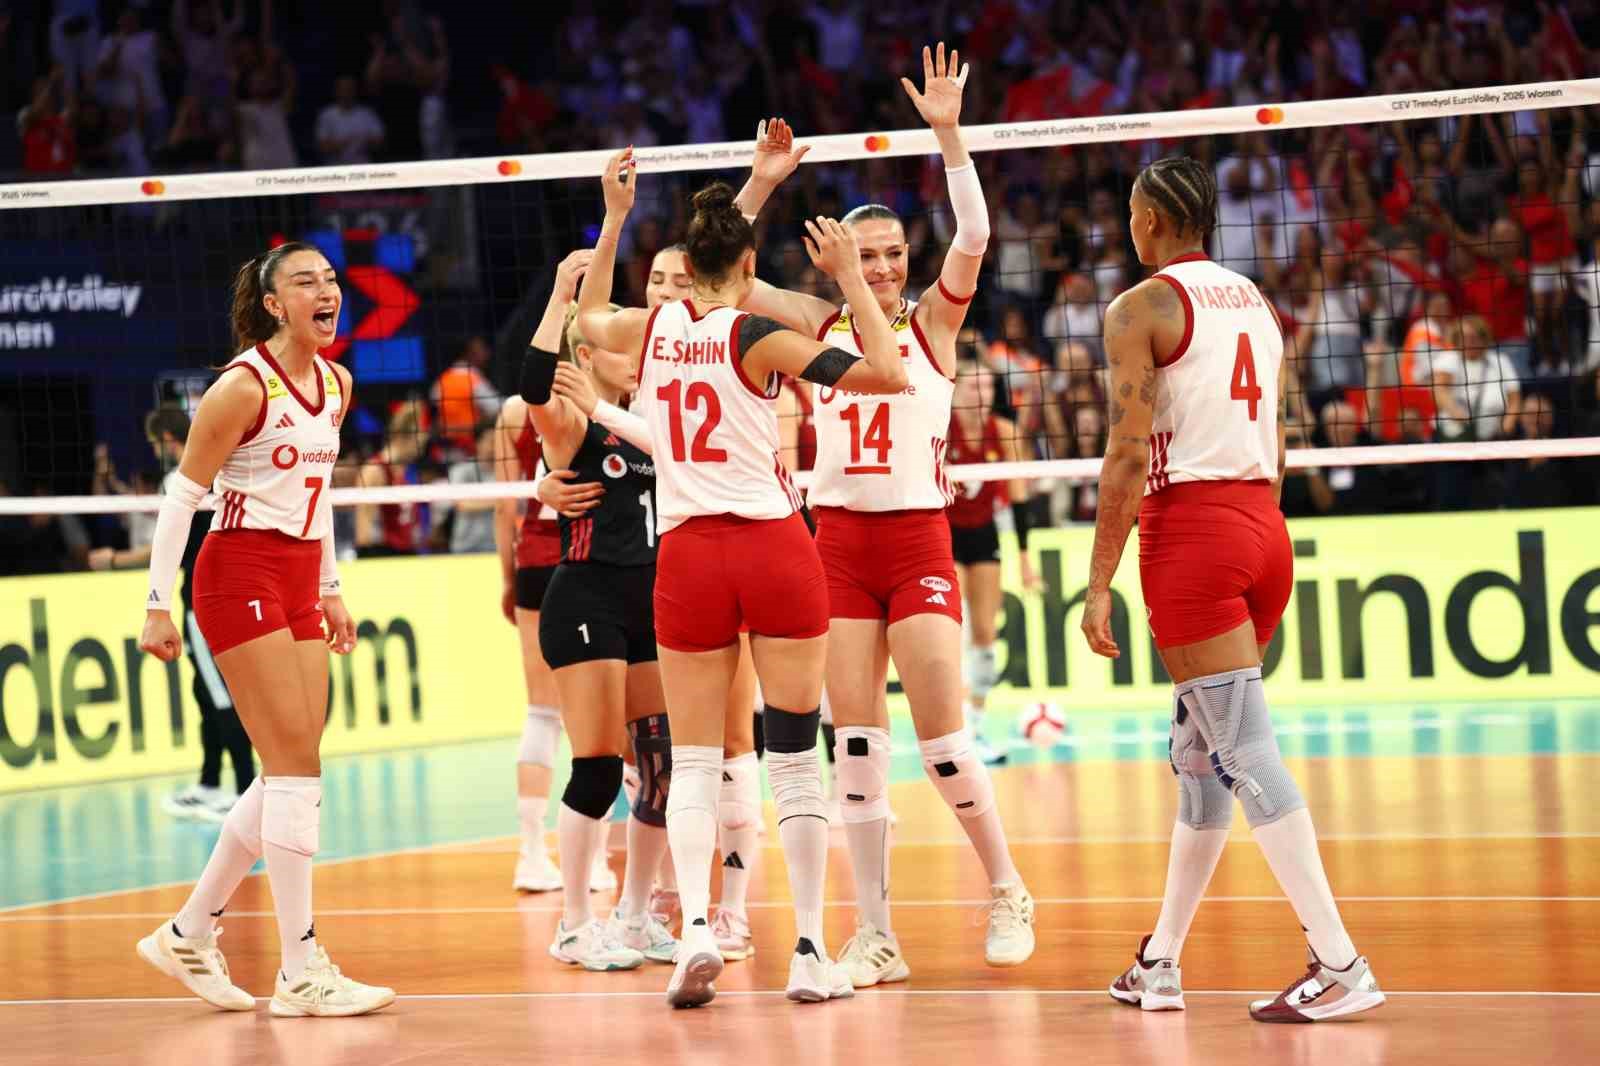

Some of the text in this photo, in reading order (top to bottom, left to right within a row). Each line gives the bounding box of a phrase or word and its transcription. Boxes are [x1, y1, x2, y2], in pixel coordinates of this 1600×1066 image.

[1391, 88, 1563, 111] CEV Trendyol EuroVolley 2026 Women
[993, 129, 1012, 139] CEV
[1013, 127, 1049, 138] Trendyol
[1051, 124, 1095, 136] EuroVolley
[1118, 120, 1152, 130] Women
[1188, 284, 1263, 309] VARGAS
[652, 336, 725, 368] E.ŞAHİN
[267, 378, 279, 389] S
[1230, 332, 1263, 422] 4
[656, 378, 728, 463] 12
[839, 402, 893, 464] 14
[301, 476, 324, 538] 7
[638, 489, 655, 548] 1
[923, 578, 950, 590] gratis
[247, 599, 263, 622] 7
[577, 623, 591, 645] 1
